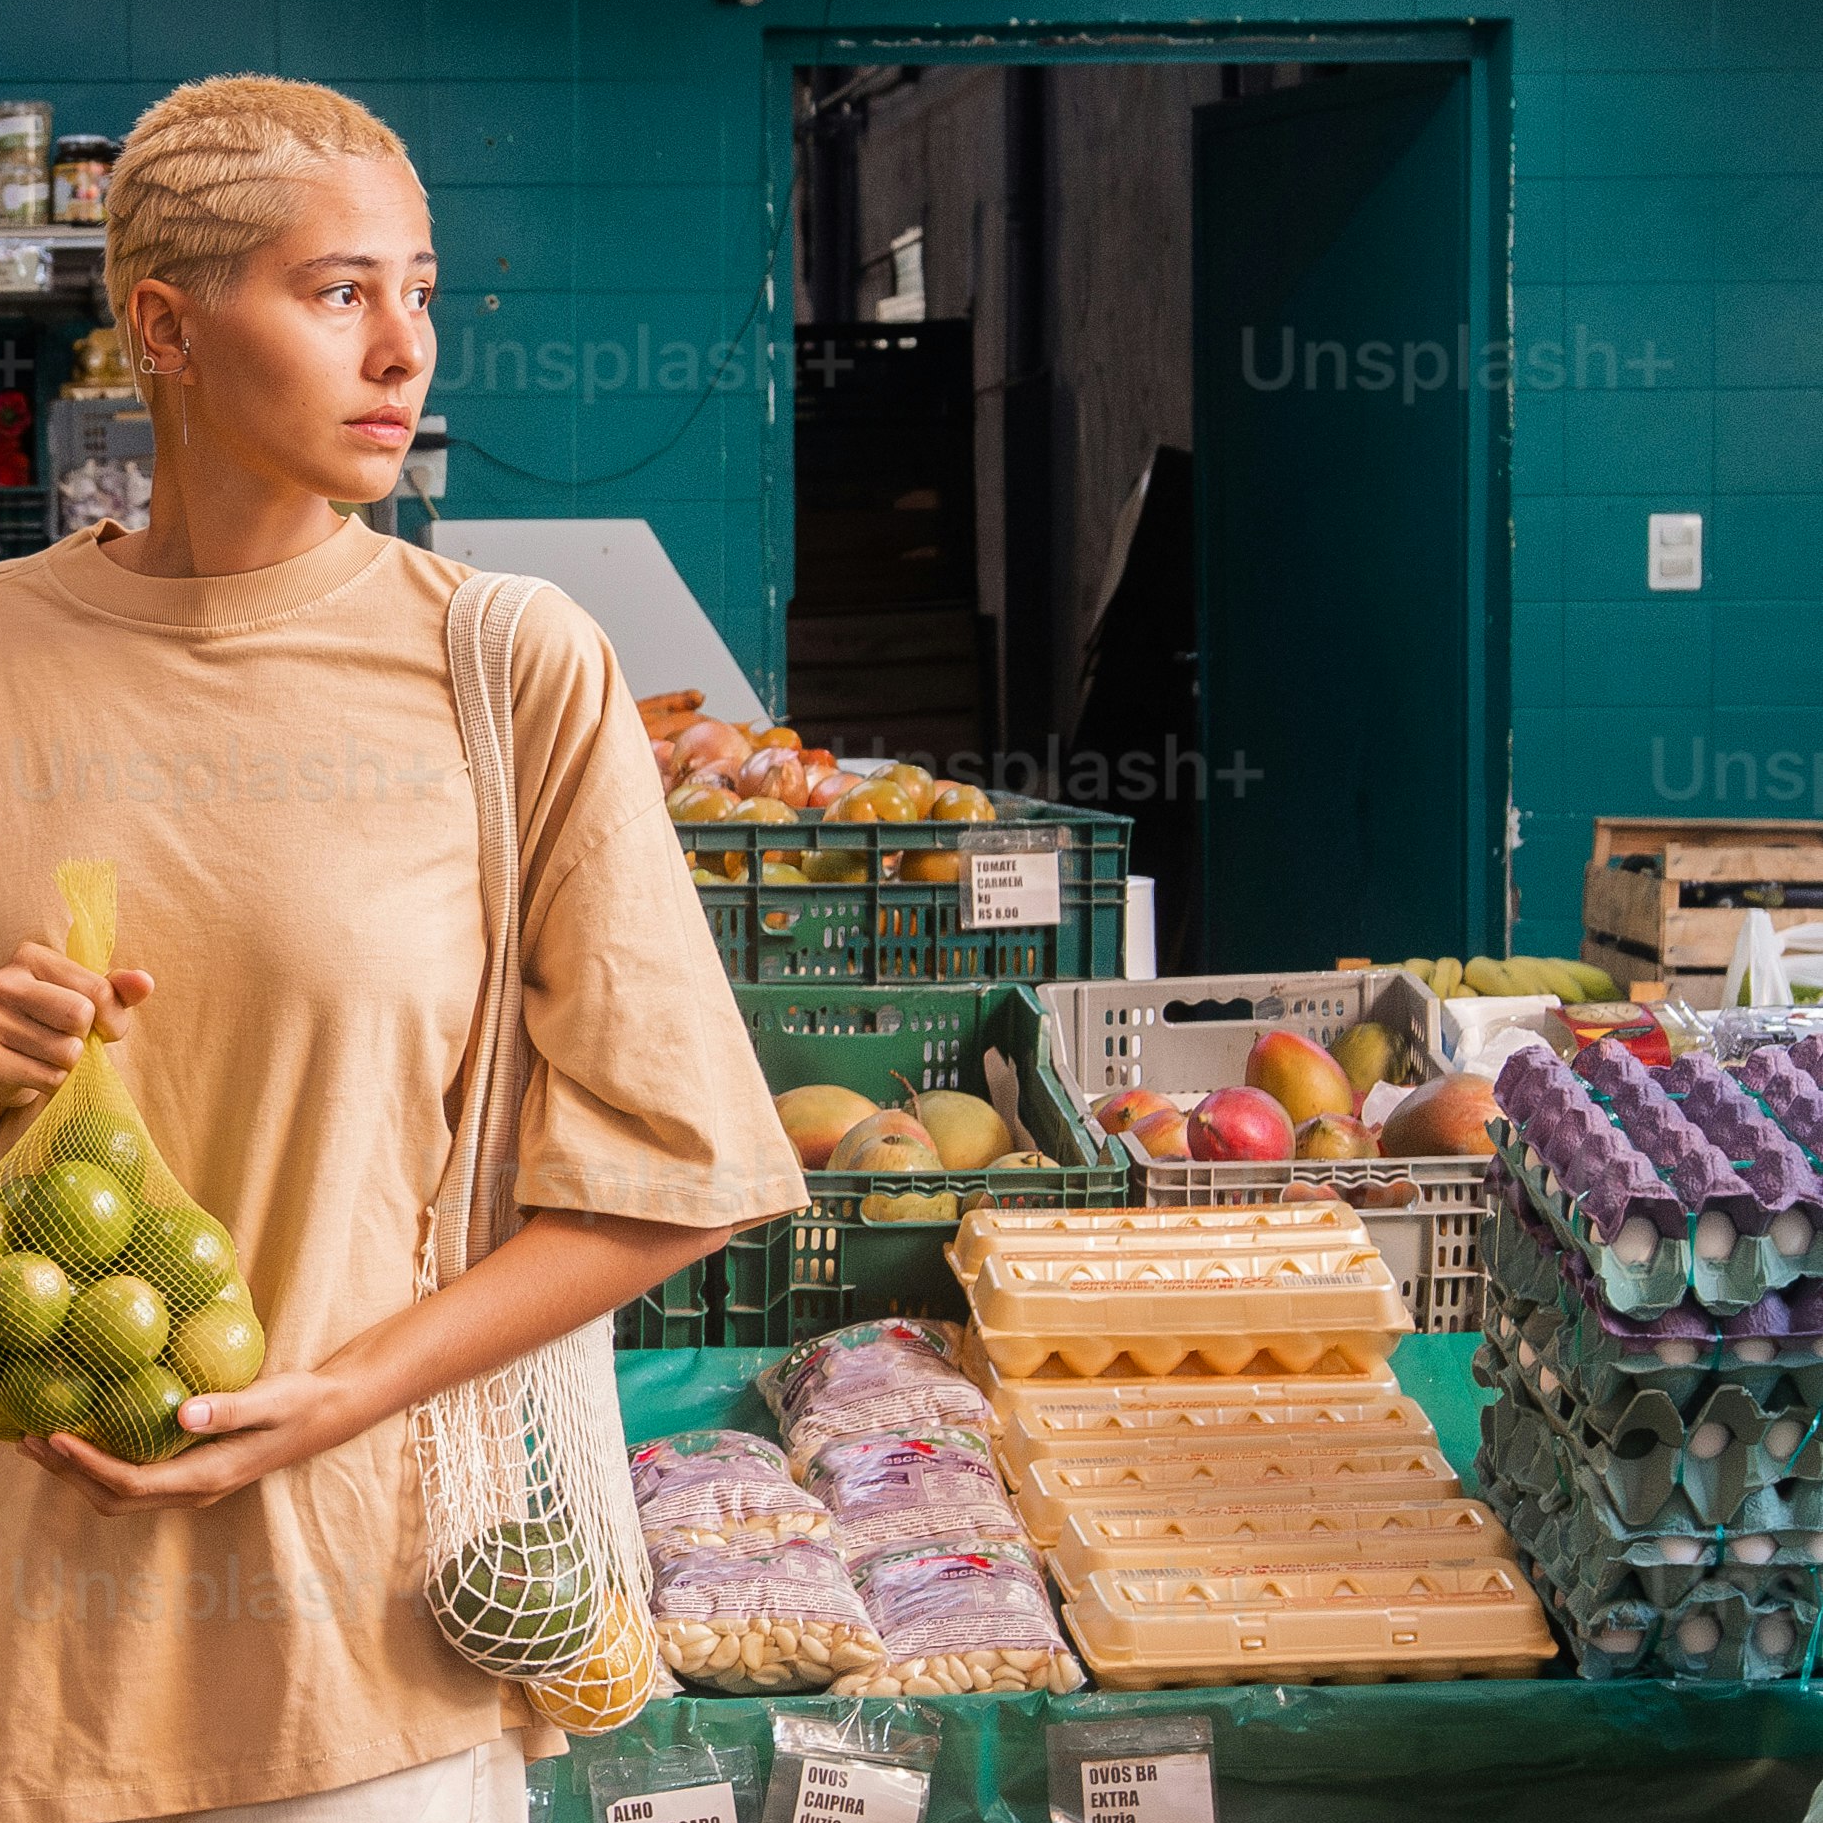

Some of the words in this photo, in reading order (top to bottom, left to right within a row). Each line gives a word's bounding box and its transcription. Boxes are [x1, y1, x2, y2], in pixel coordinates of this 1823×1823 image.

[977, 860, 1017, 872] TOMATE
[808, 1766, 849, 1788] OVOS
[1089, 1766, 1132, 1785] OVOS
[1136, 1764, 1158, 1782] BR
[804, 1790, 865, 1815] CAIPIRA
[1091, 1790, 1140, 1808] EXTRA
[613, 1801, 653, 1823] ALHO
